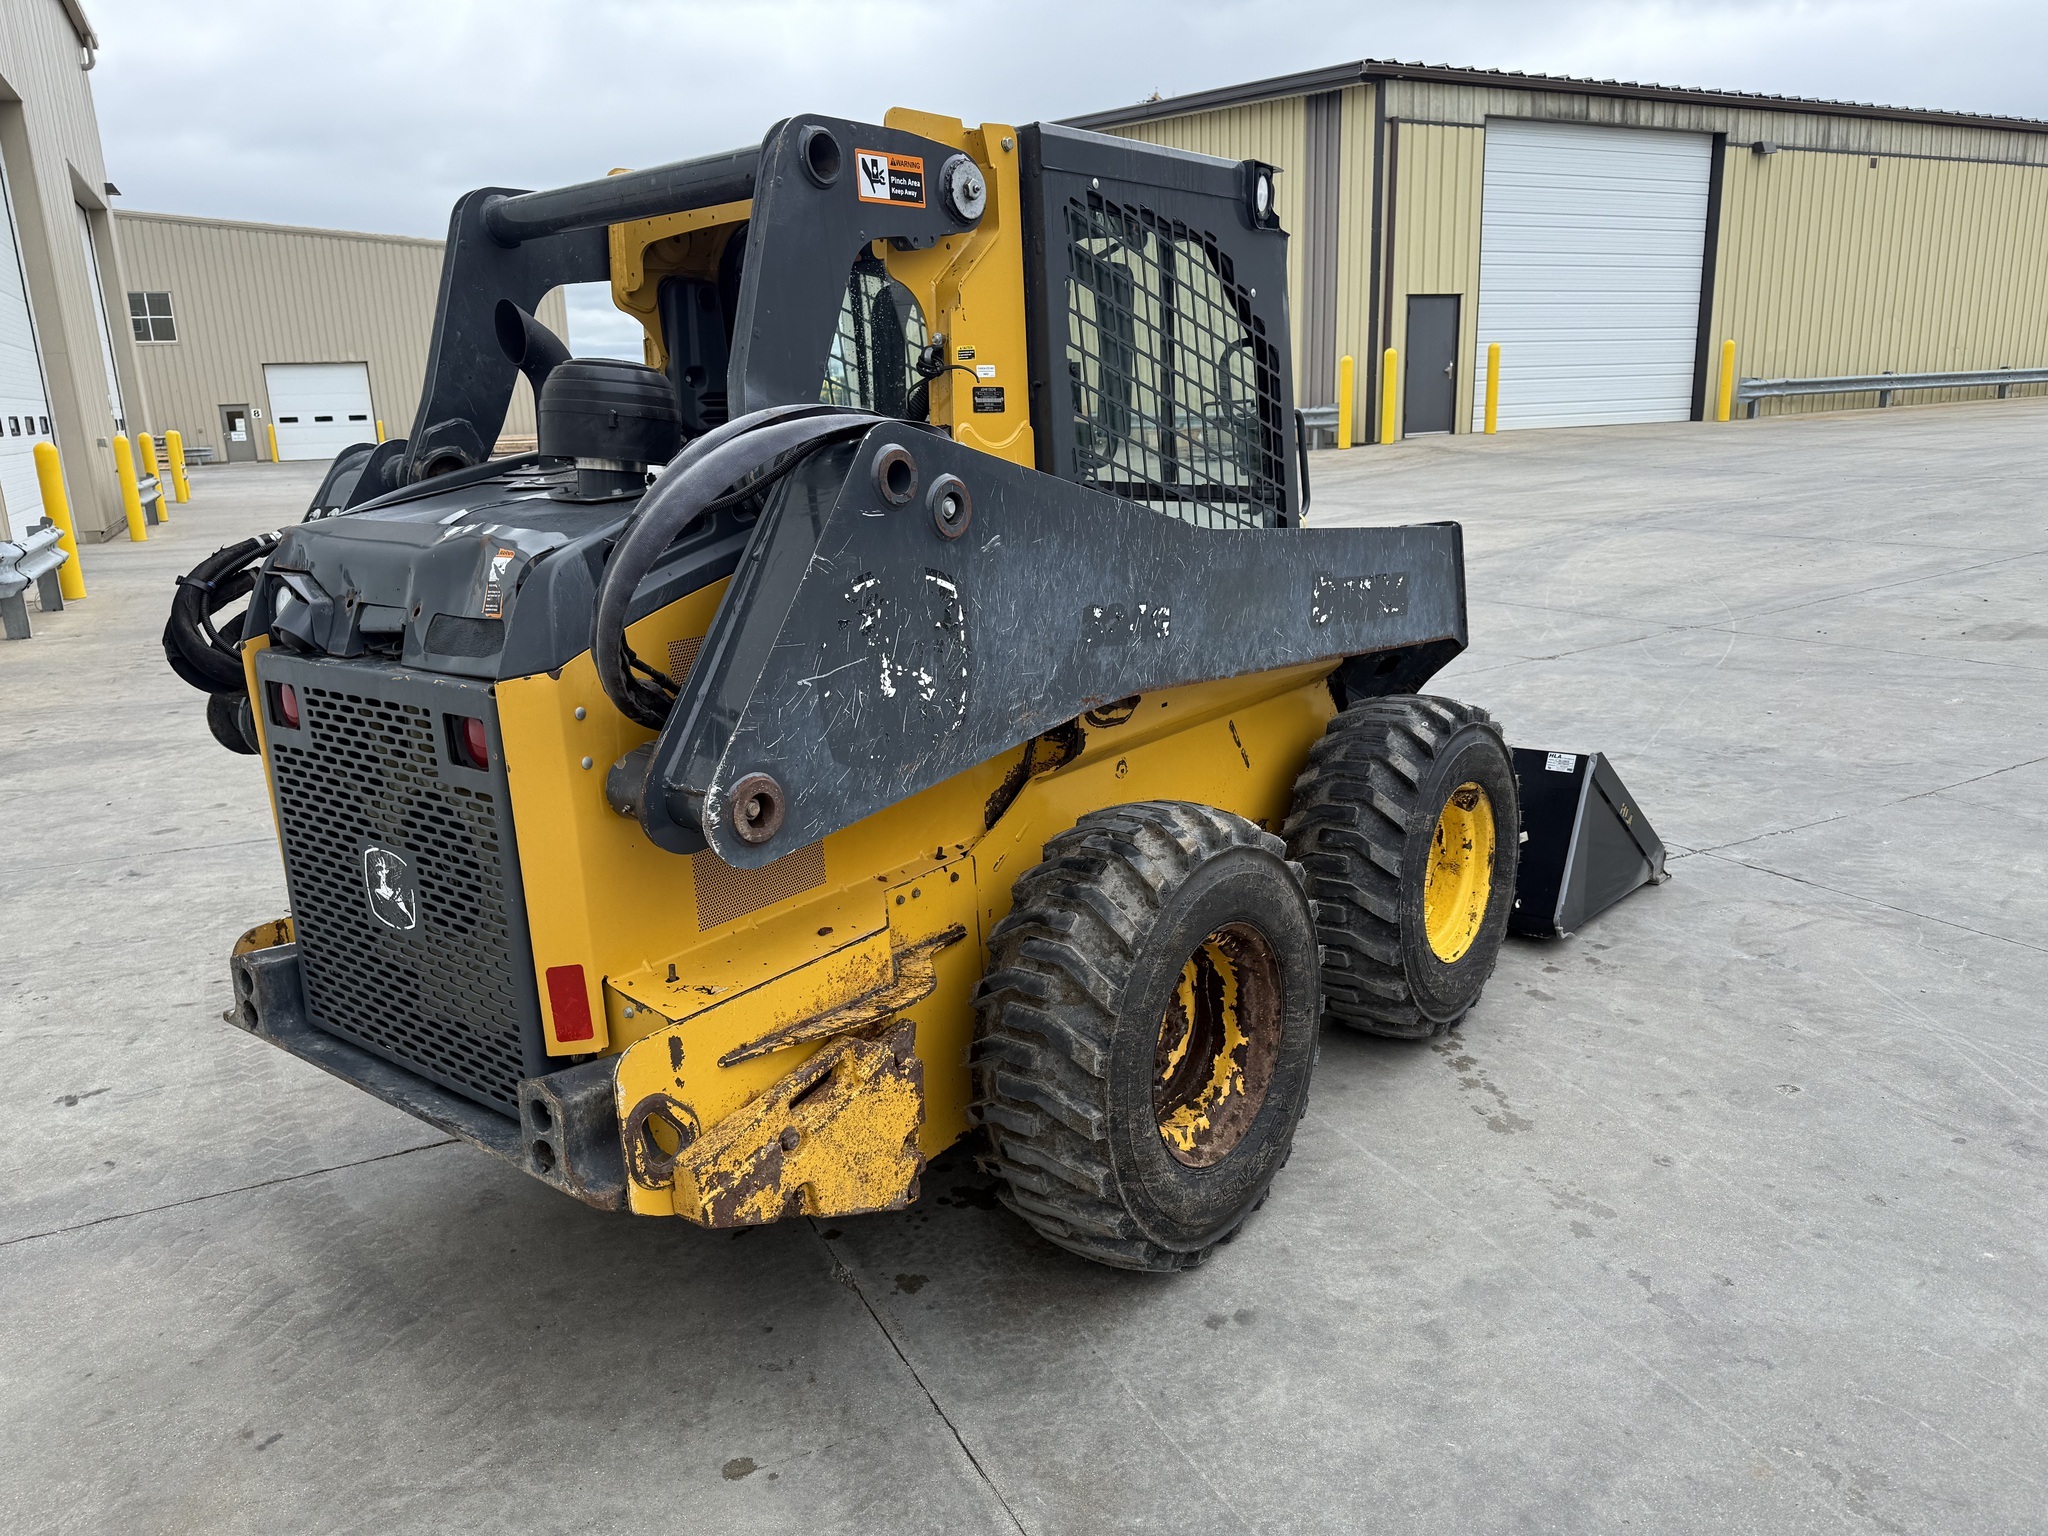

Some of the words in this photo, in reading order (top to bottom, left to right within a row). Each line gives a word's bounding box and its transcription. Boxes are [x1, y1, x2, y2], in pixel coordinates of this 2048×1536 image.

[896, 160, 920, 169] WARNING
[890, 176, 906, 185] Pinch
[908, 178, 920, 187] Area
[891, 187, 904, 196] Keep
[905, 189, 917, 197] Away
[253, 410, 260, 418] 8
